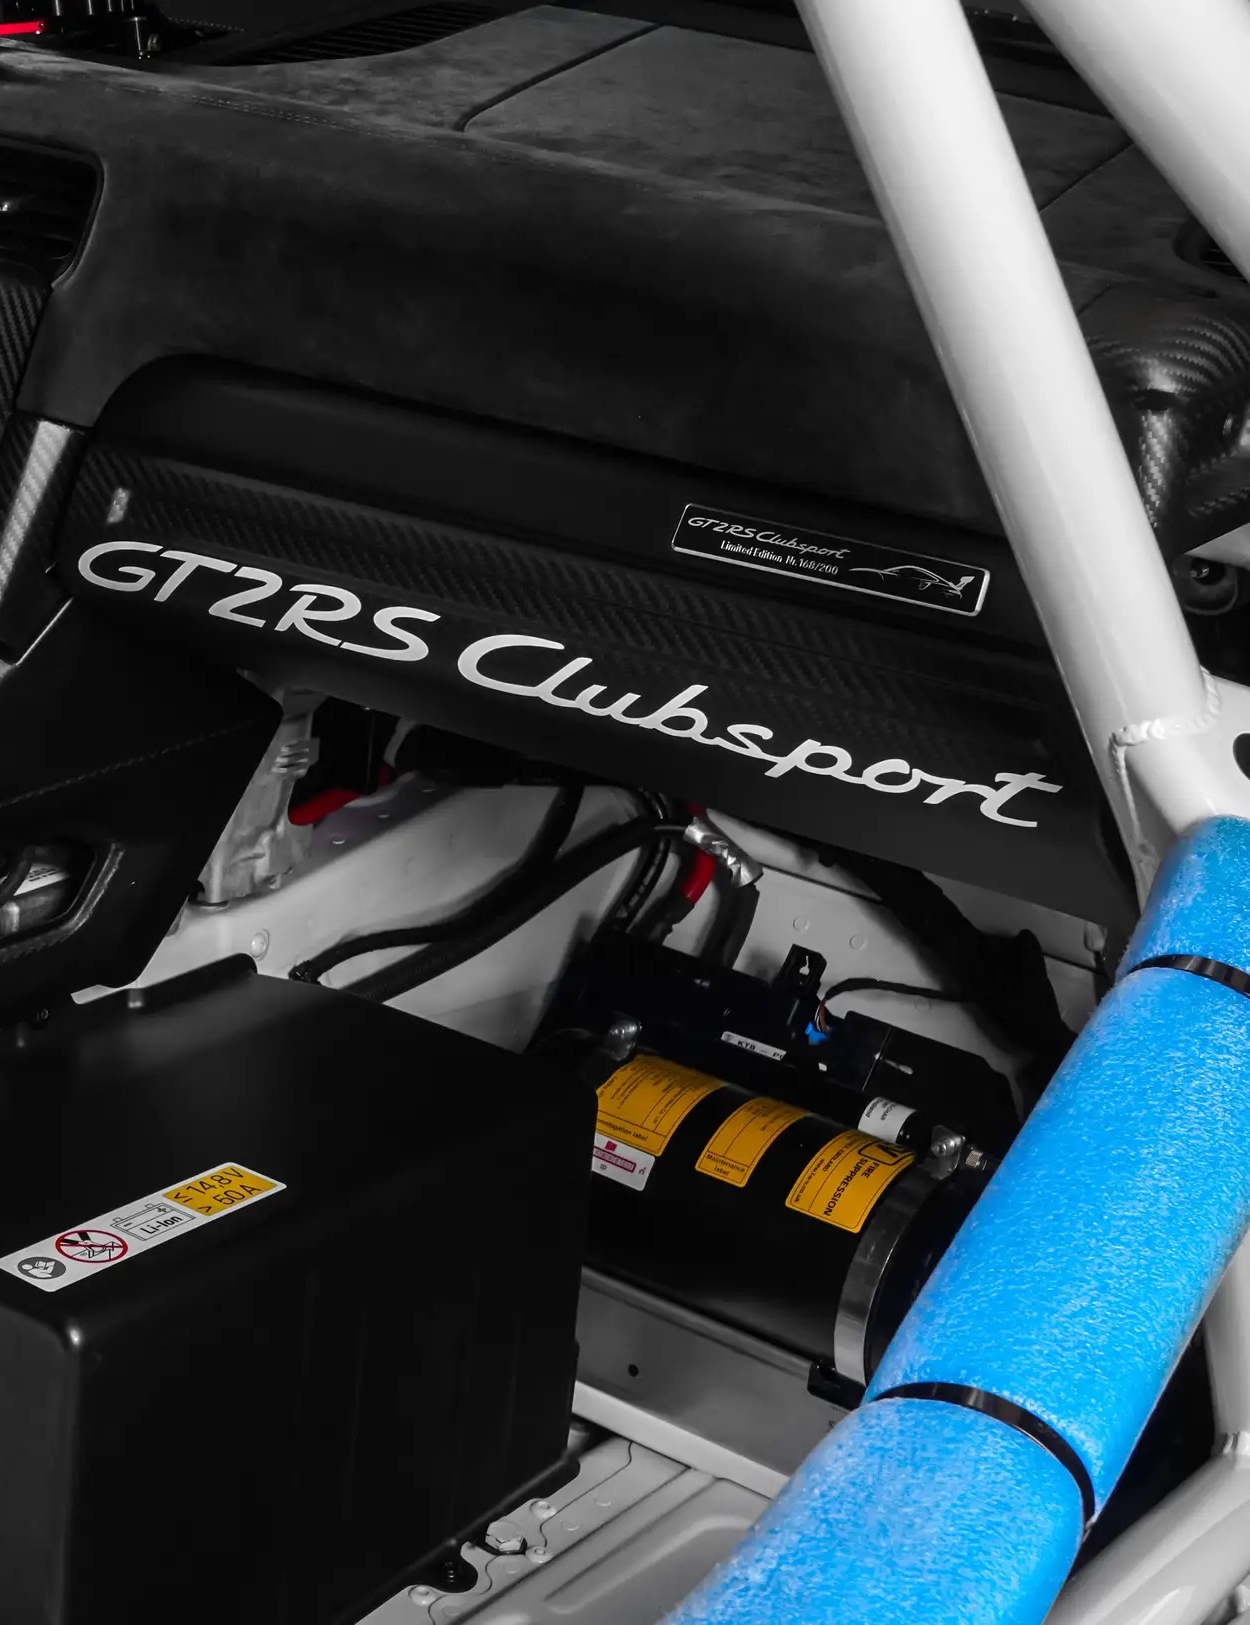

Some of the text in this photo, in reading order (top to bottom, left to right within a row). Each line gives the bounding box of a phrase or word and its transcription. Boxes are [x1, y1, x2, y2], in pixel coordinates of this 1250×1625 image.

[720, 540, 753, 556] Limited
[753, 547, 783, 564] Edition
[755, 531, 851, 559] Clubsport
[457, 634, 1064, 828] Clubsport
[706, 1154, 745, 1173] Maintenance
[714, 1165, 730, 1176] label
[861, 1161, 880, 1179] FIRE
[823, 1158, 869, 1217] SUPPRESSION
[140, 1214, 183, 1236] Li-Ion
